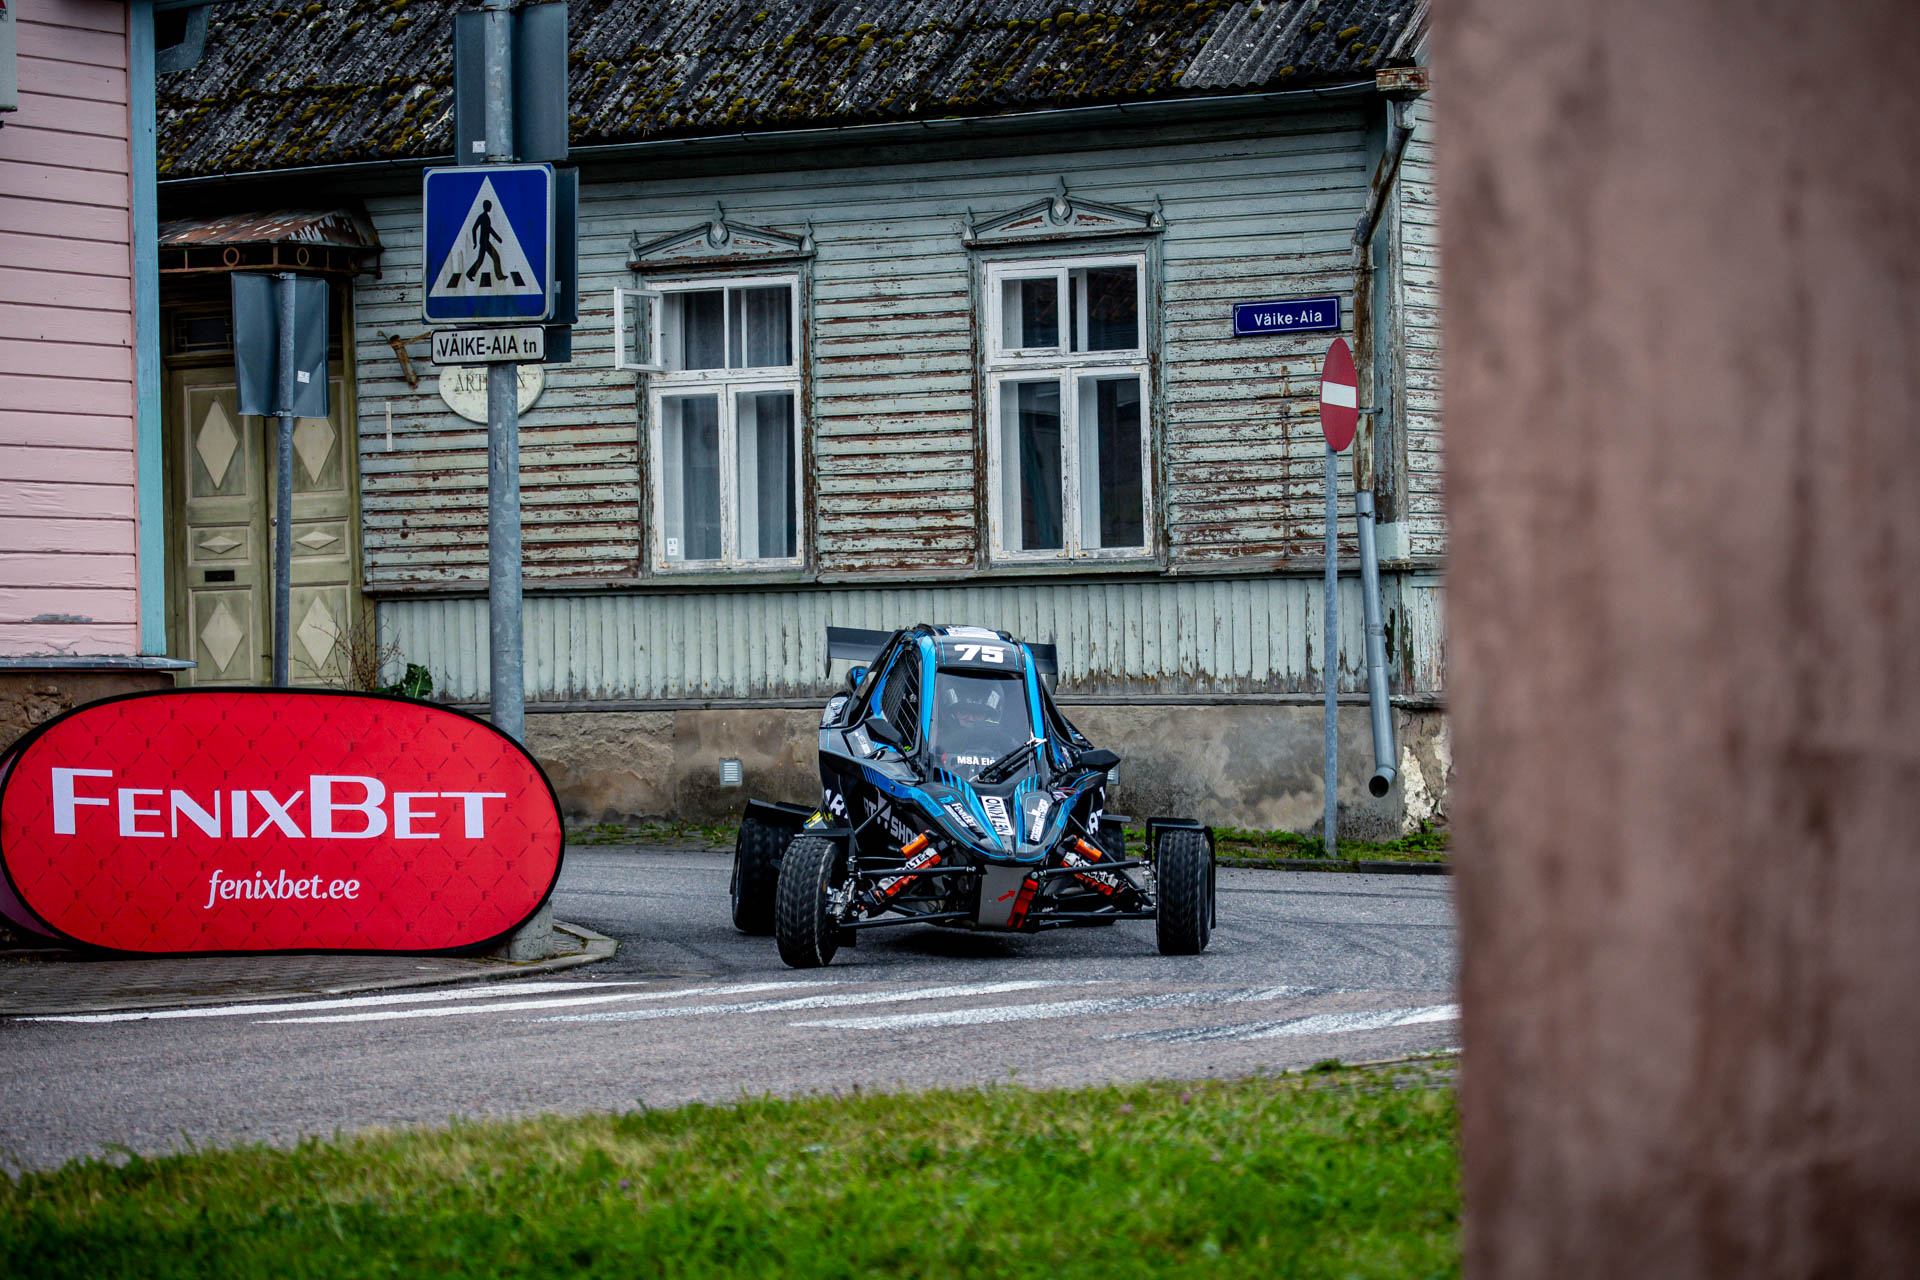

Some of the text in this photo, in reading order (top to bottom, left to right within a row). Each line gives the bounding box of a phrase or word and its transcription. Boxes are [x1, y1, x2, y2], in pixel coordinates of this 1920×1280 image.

[1254, 309, 1323, 327] Väike-Aia
[439, 333, 537, 357] VÄIKE-AIA tn
[954, 644, 1006, 664] 75
[957, 755, 980, 766] MSA
[890, 815, 919, 846] SHO
[203, 869, 360, 909] fenixbet.ee
